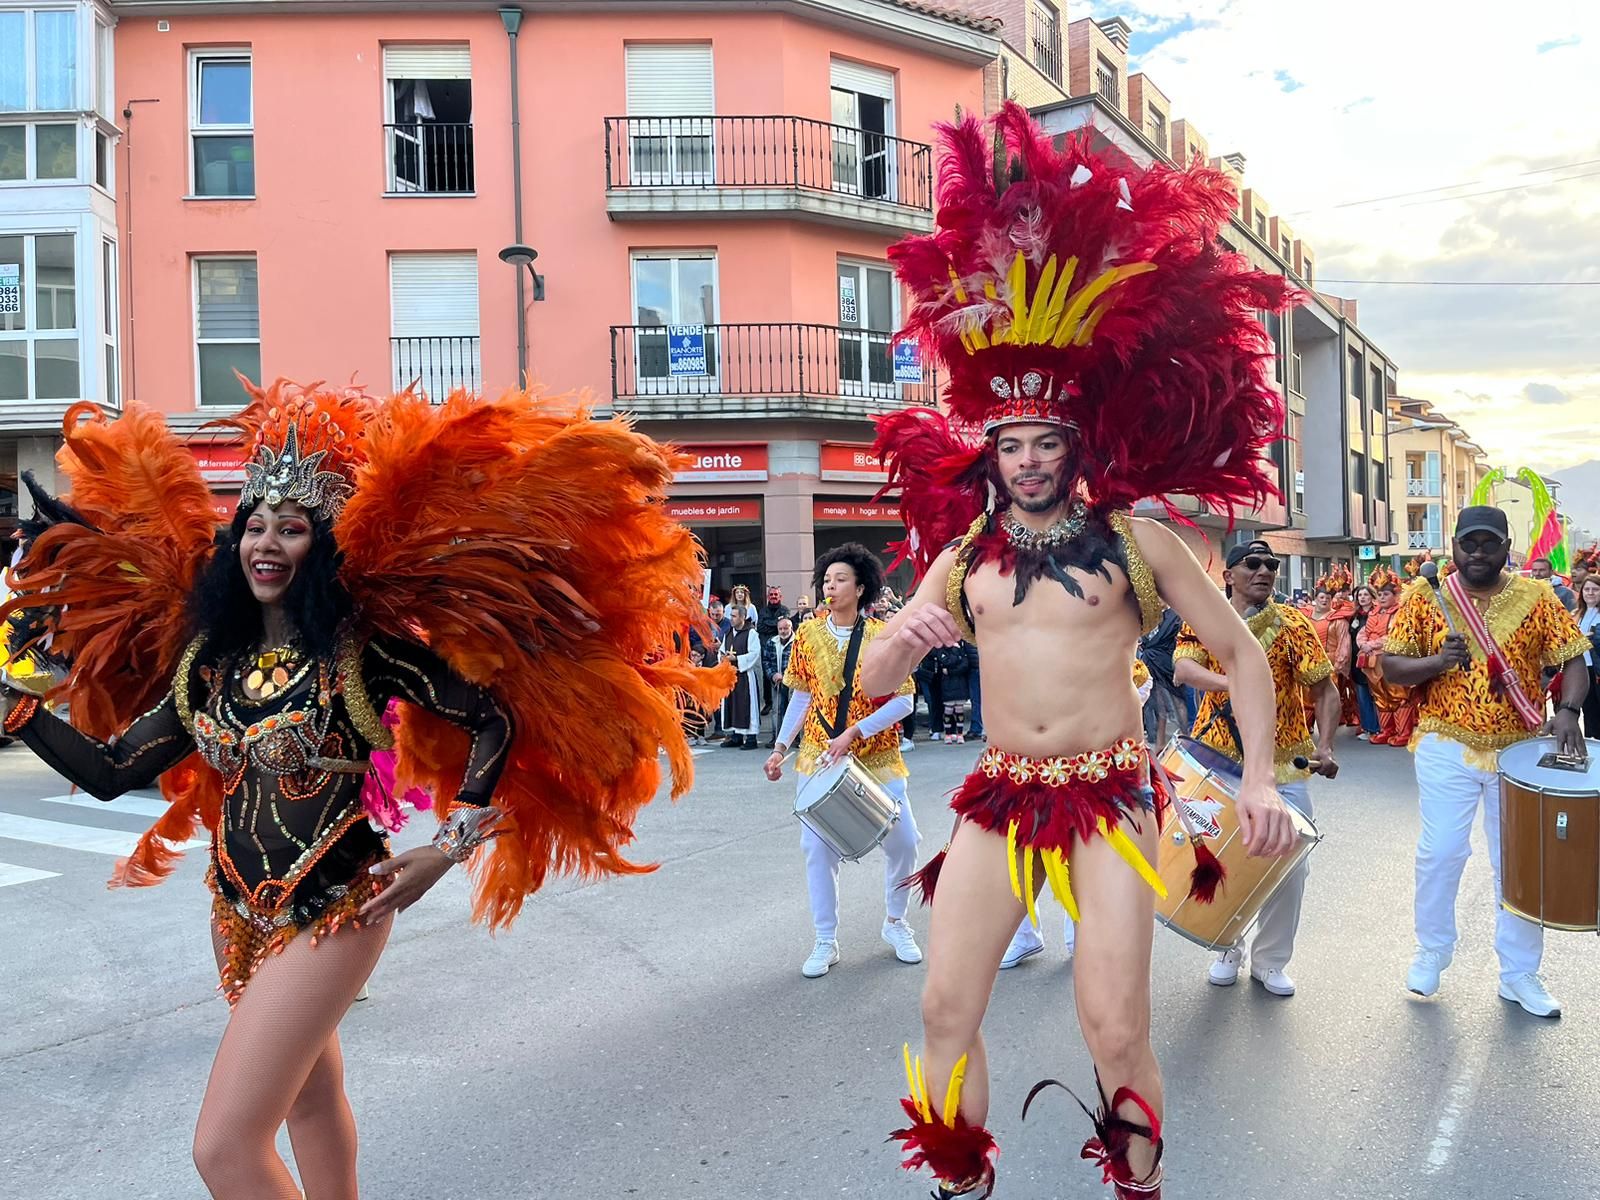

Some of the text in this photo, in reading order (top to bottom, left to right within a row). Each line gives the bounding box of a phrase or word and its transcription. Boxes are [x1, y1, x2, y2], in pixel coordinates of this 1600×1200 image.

[0, 286, 18, 295] 984
[0, 304, 18, 312] 366
[670, 326, 702, 336] VENDE
[671, 507, 704, 516] muebles
[706, 506, 716, 514] de
[824, 506, 847, 516] menaje
[860, 506, 878, 516] hogar
